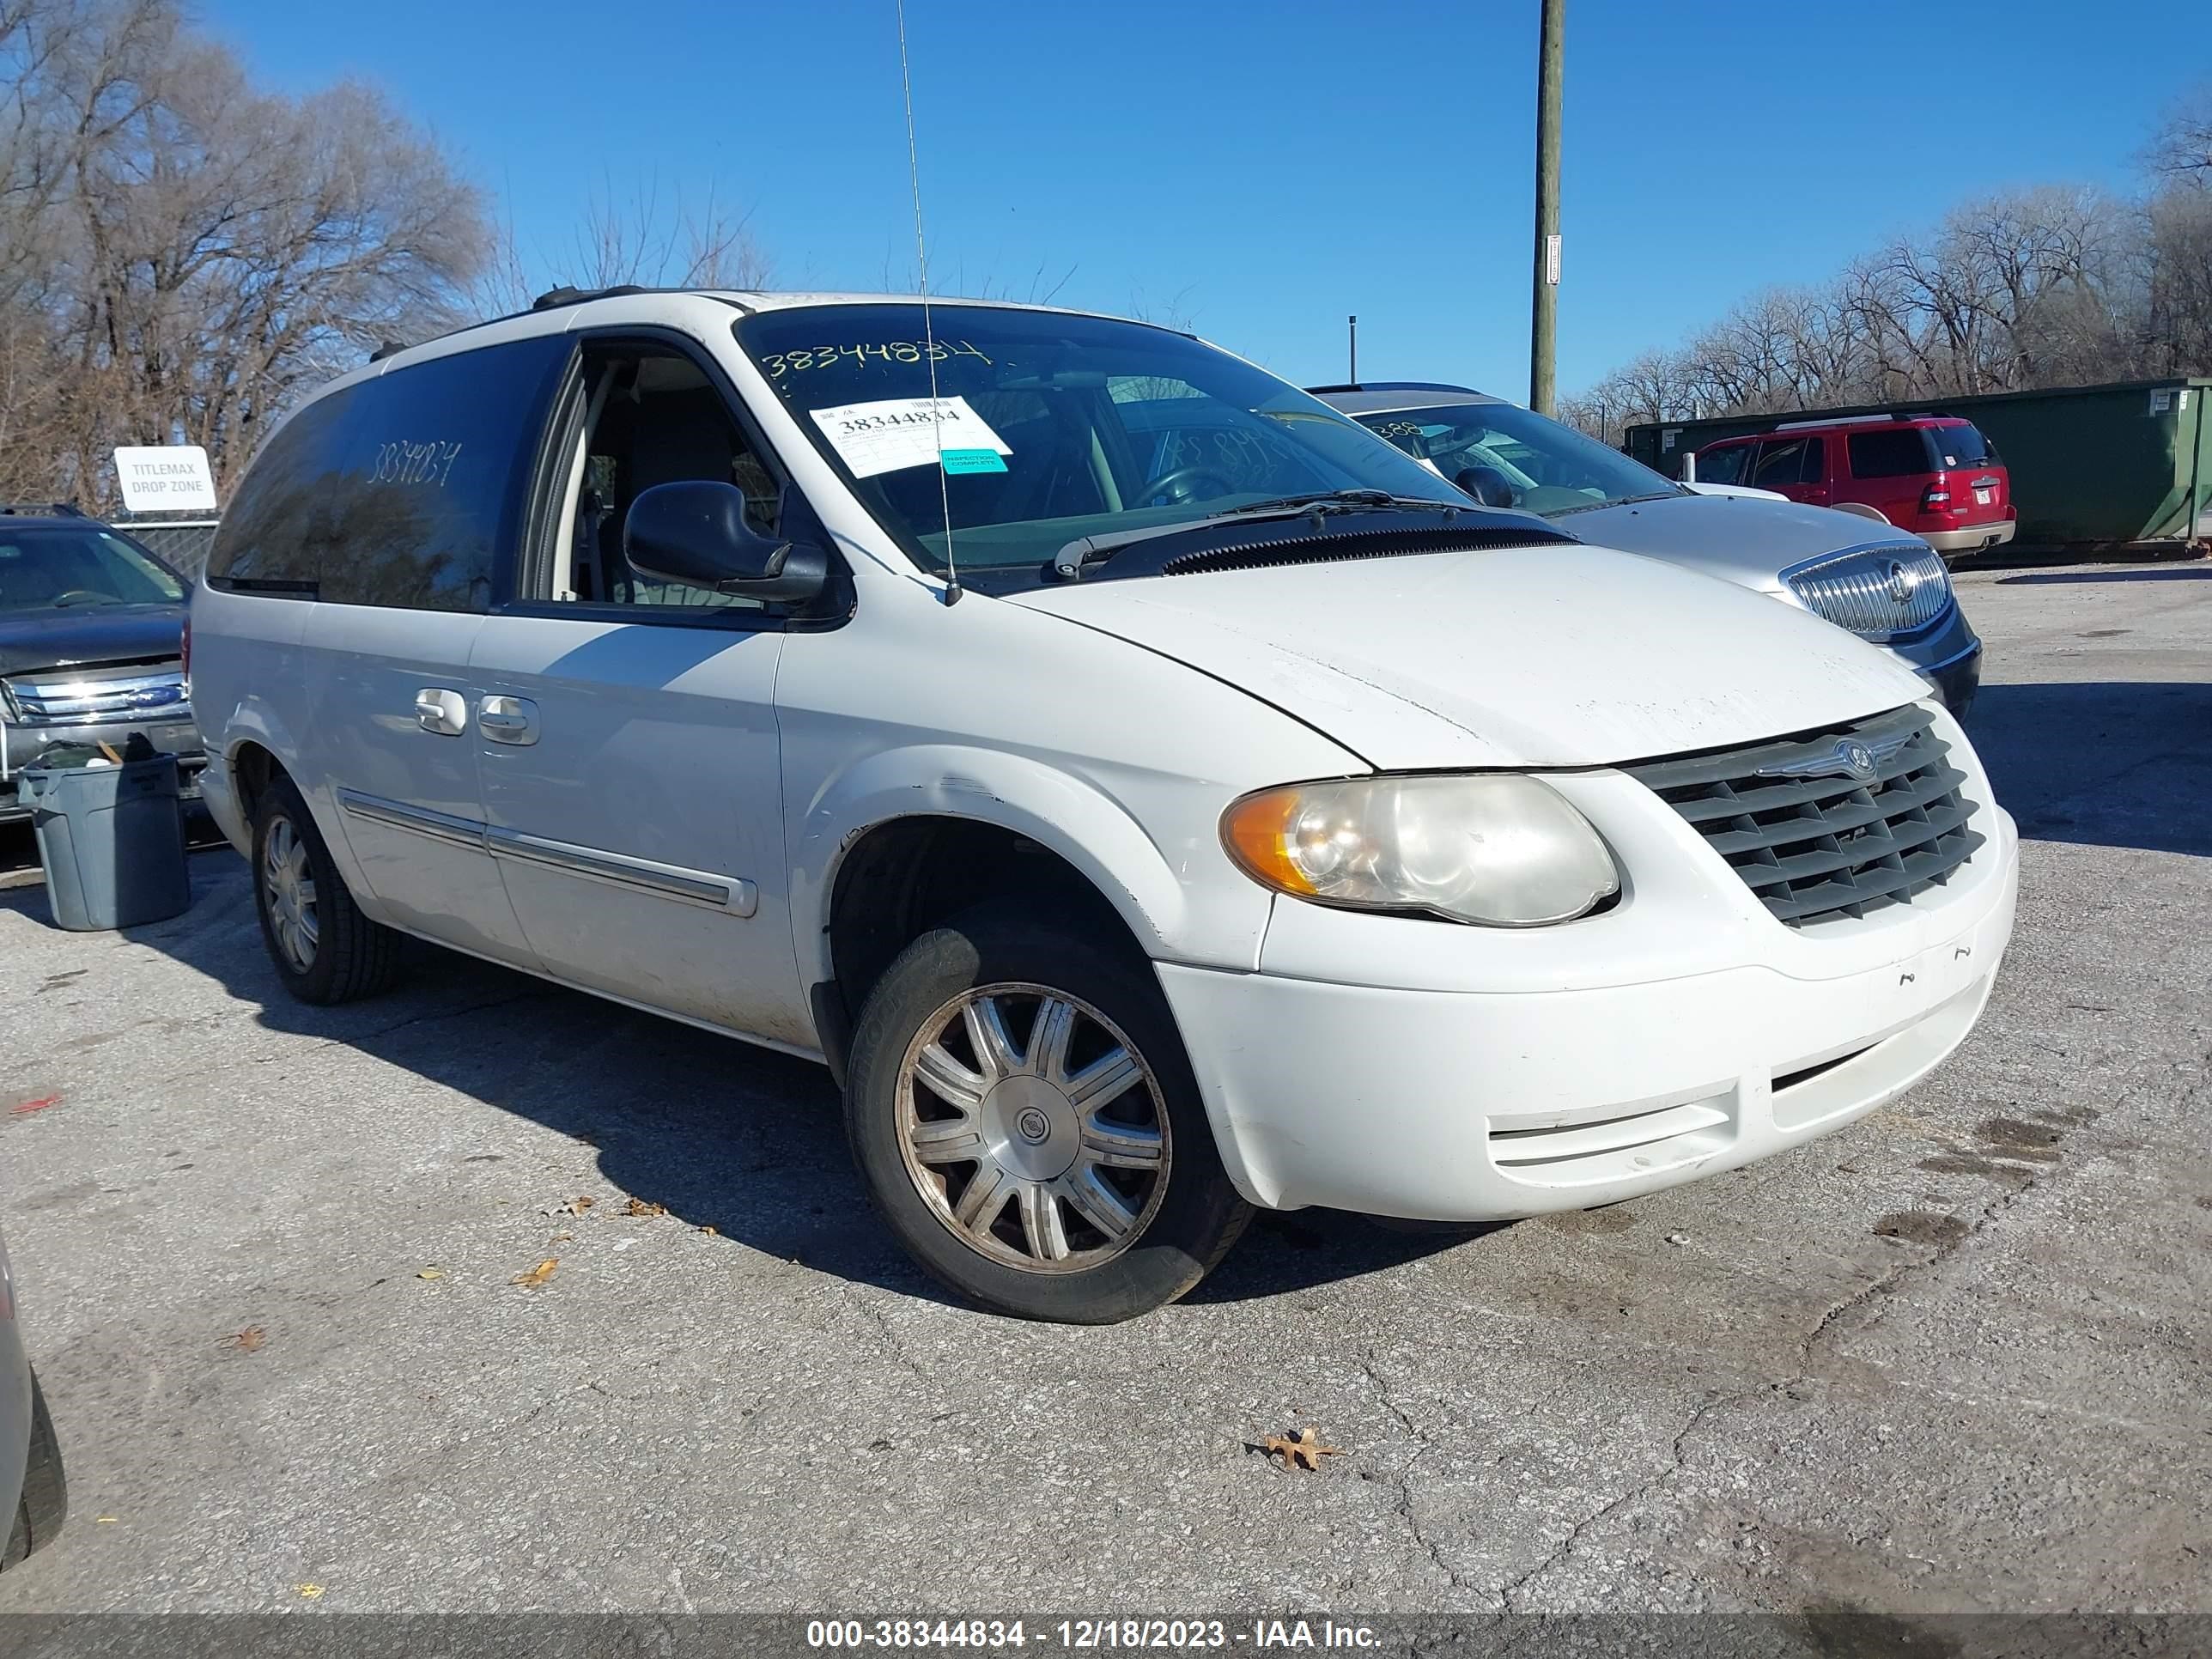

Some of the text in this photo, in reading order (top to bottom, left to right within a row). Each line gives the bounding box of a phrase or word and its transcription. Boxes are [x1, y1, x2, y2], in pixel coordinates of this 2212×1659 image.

[762, 339, 991, 378] 38344834
[838, 410, 960, 434] 38344834
[131, 464, 196, 476] TITLEMAX
[368, 439, 462, 488] 38344834
[131, 481, 204, 493] DROP ZONE
